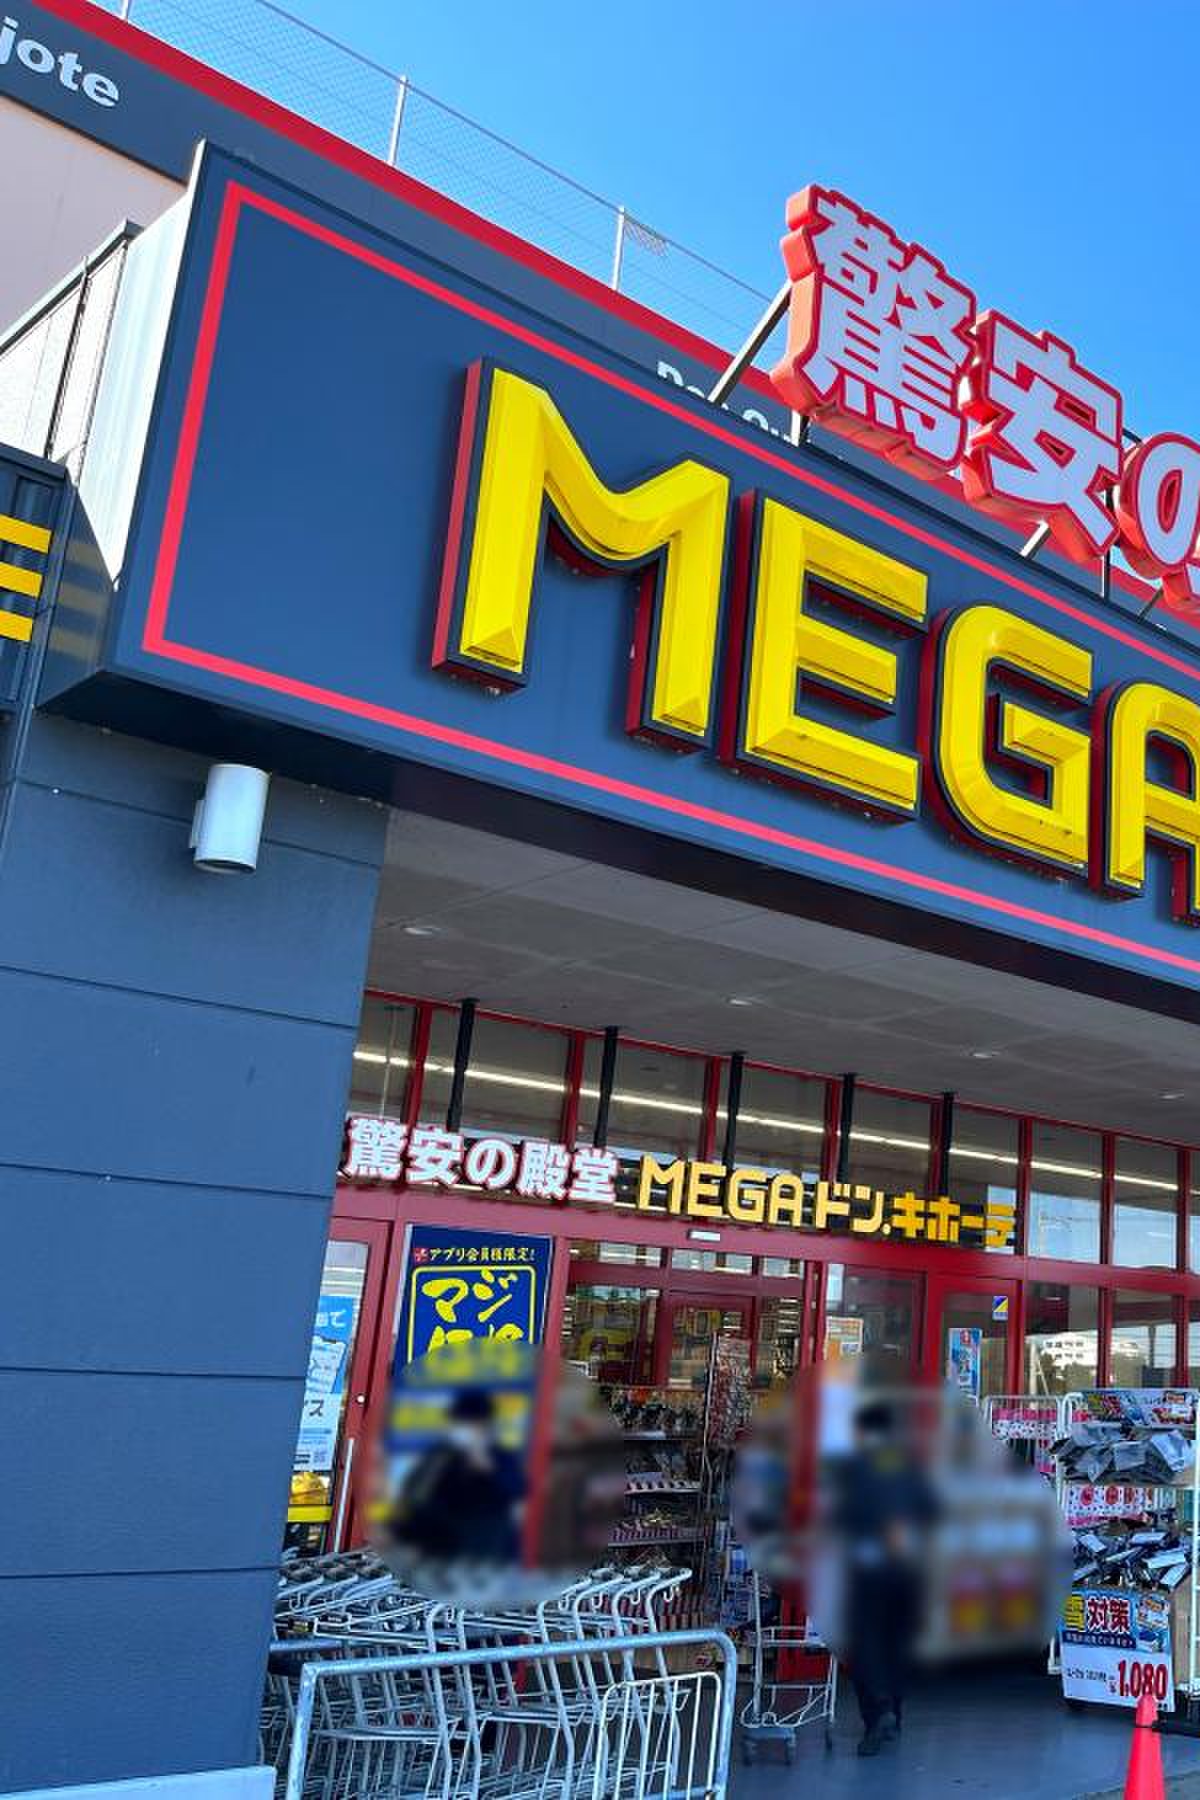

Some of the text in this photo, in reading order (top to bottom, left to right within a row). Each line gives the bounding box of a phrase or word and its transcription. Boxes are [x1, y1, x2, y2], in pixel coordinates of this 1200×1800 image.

[348, 1118, 618, 1204] 驚安の殿堂
